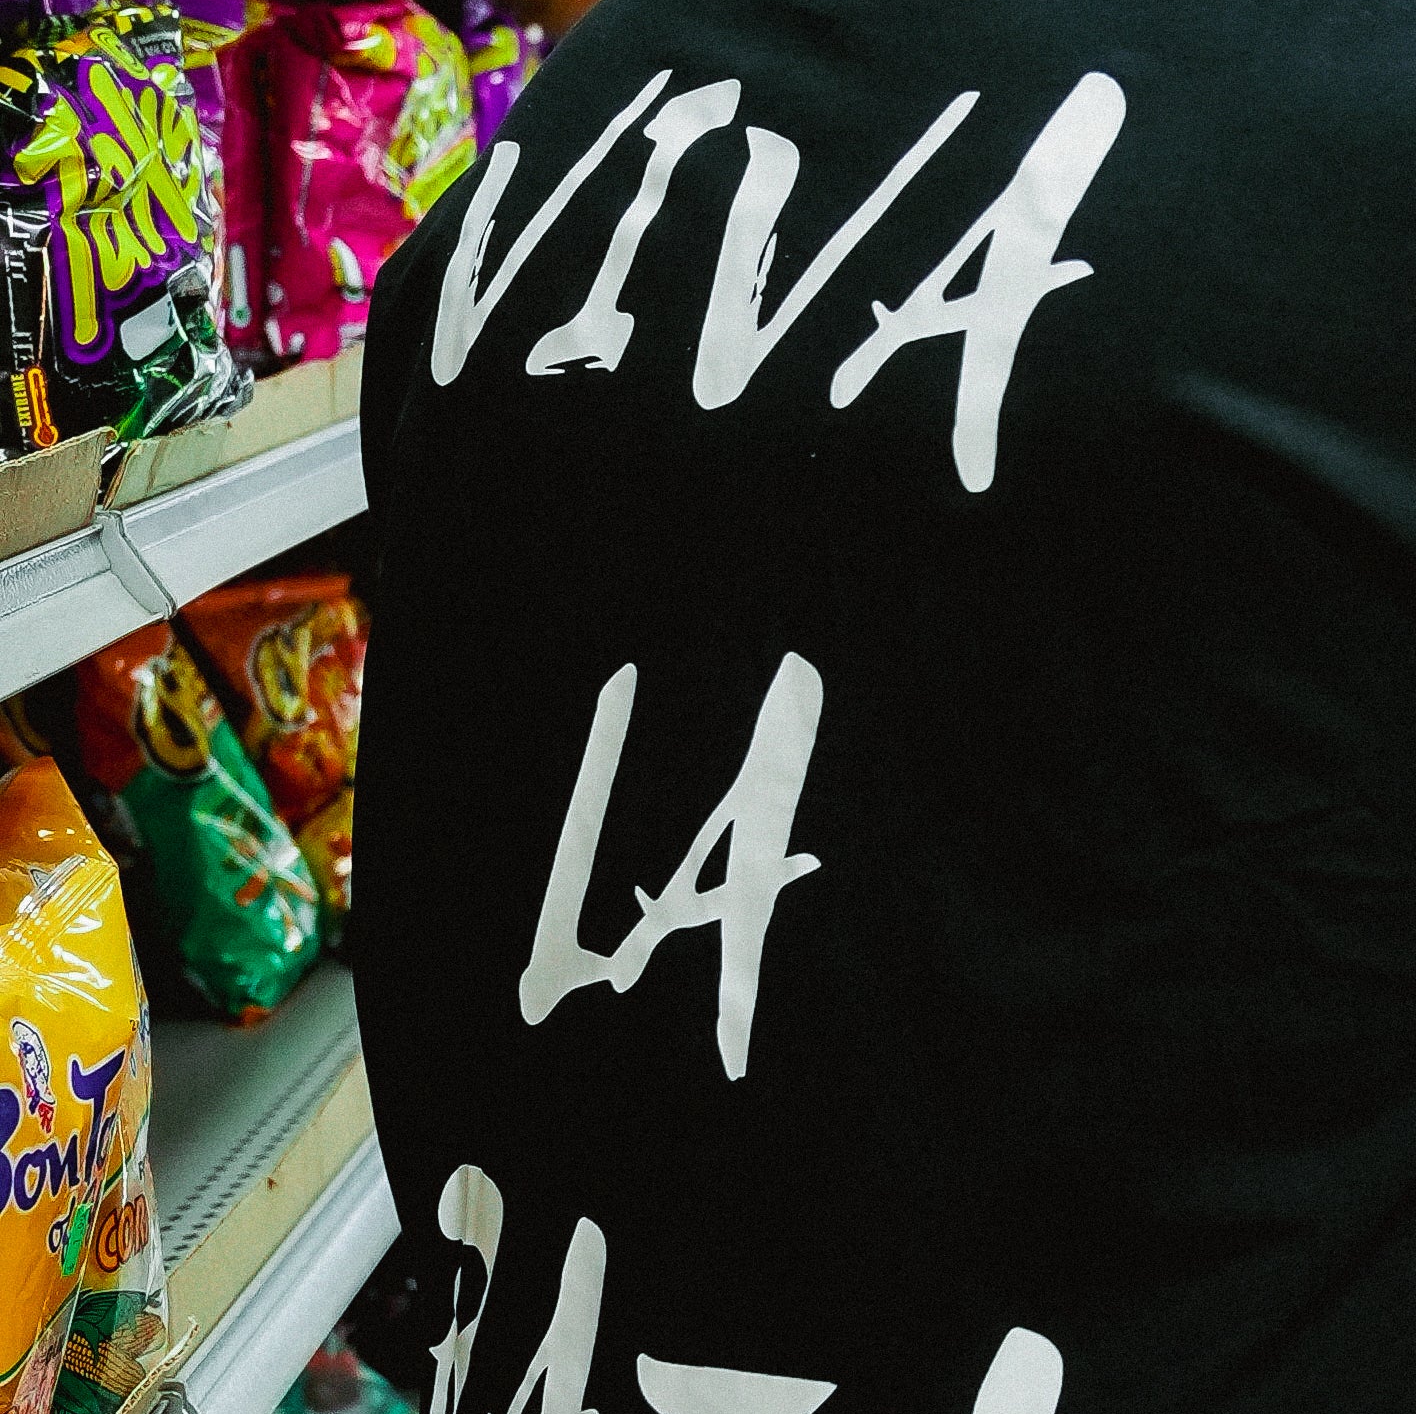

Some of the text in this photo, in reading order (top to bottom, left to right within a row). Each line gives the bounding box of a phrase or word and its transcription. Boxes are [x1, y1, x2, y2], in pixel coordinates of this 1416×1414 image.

[10, 373, 33, 428] EXTREME
[431, 68, 1126, 493] VIVA
[519, 651, 823, 1081] LA
